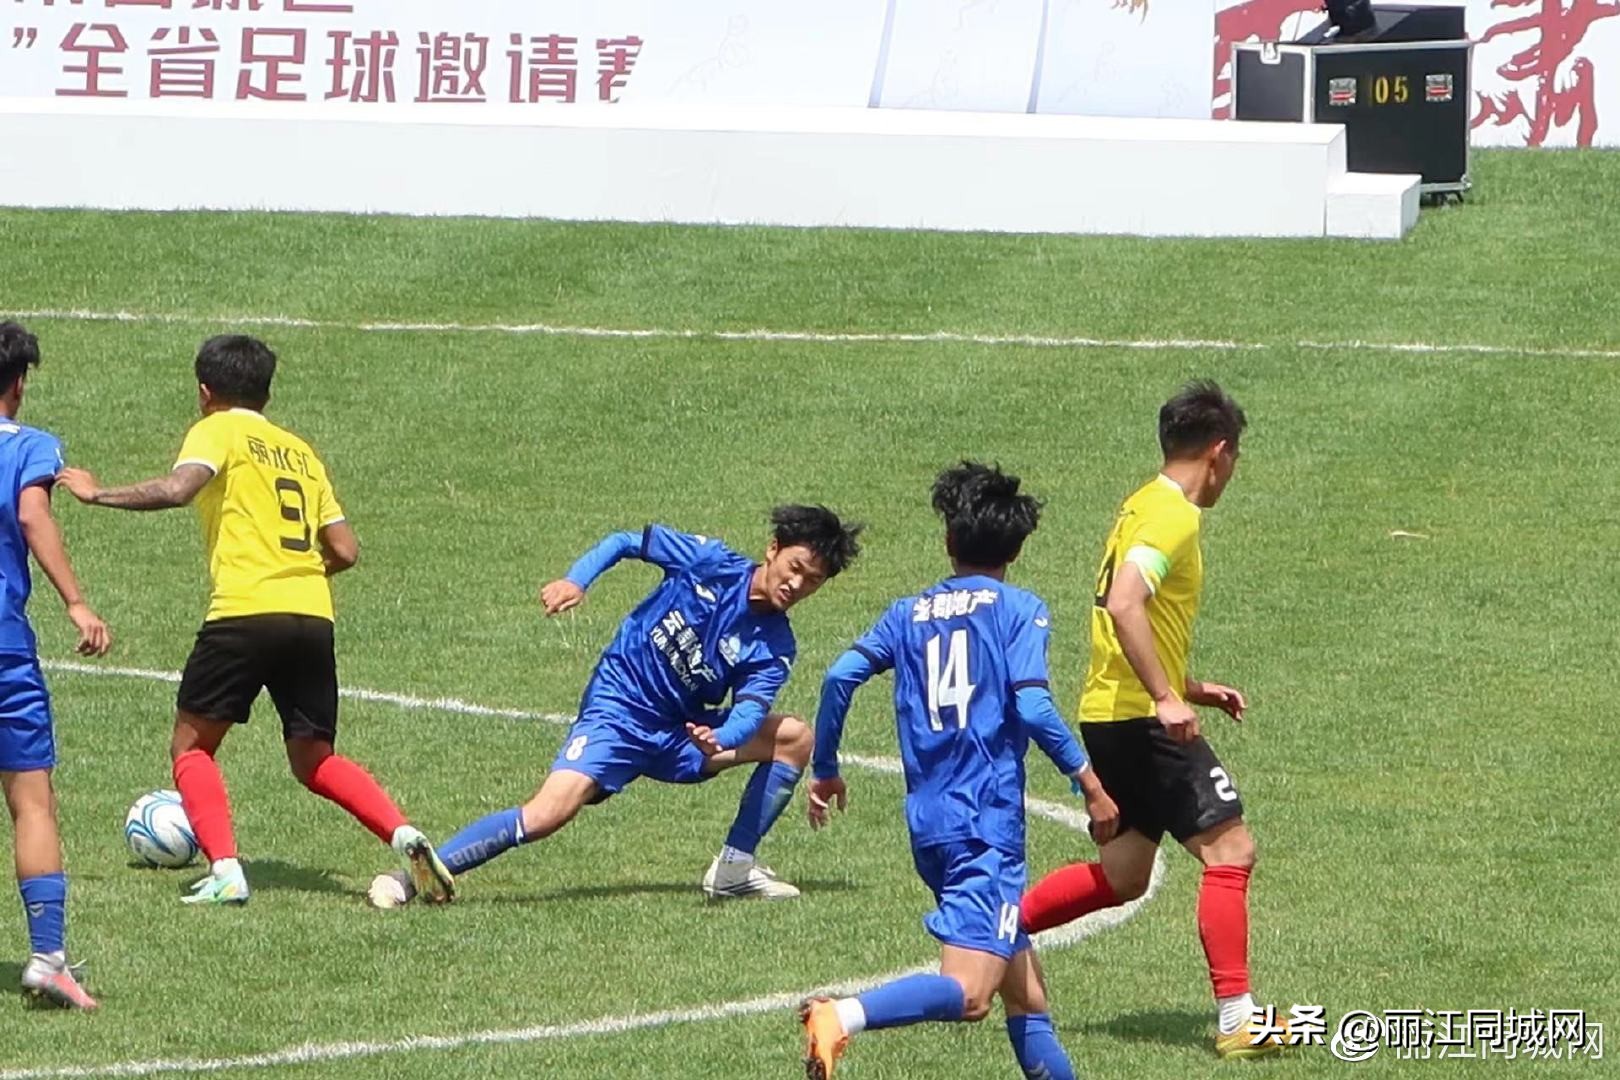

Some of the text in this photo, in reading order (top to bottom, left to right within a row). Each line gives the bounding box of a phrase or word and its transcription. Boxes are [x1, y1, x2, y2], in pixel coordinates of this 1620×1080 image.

[1374, 75, 1409, 104] 05
[275, 476, 311, 552] 9
[927, 629, 977, 731] 14
[565, 735, 588, 761] 8
[998, 902, 1019, 944] 14
